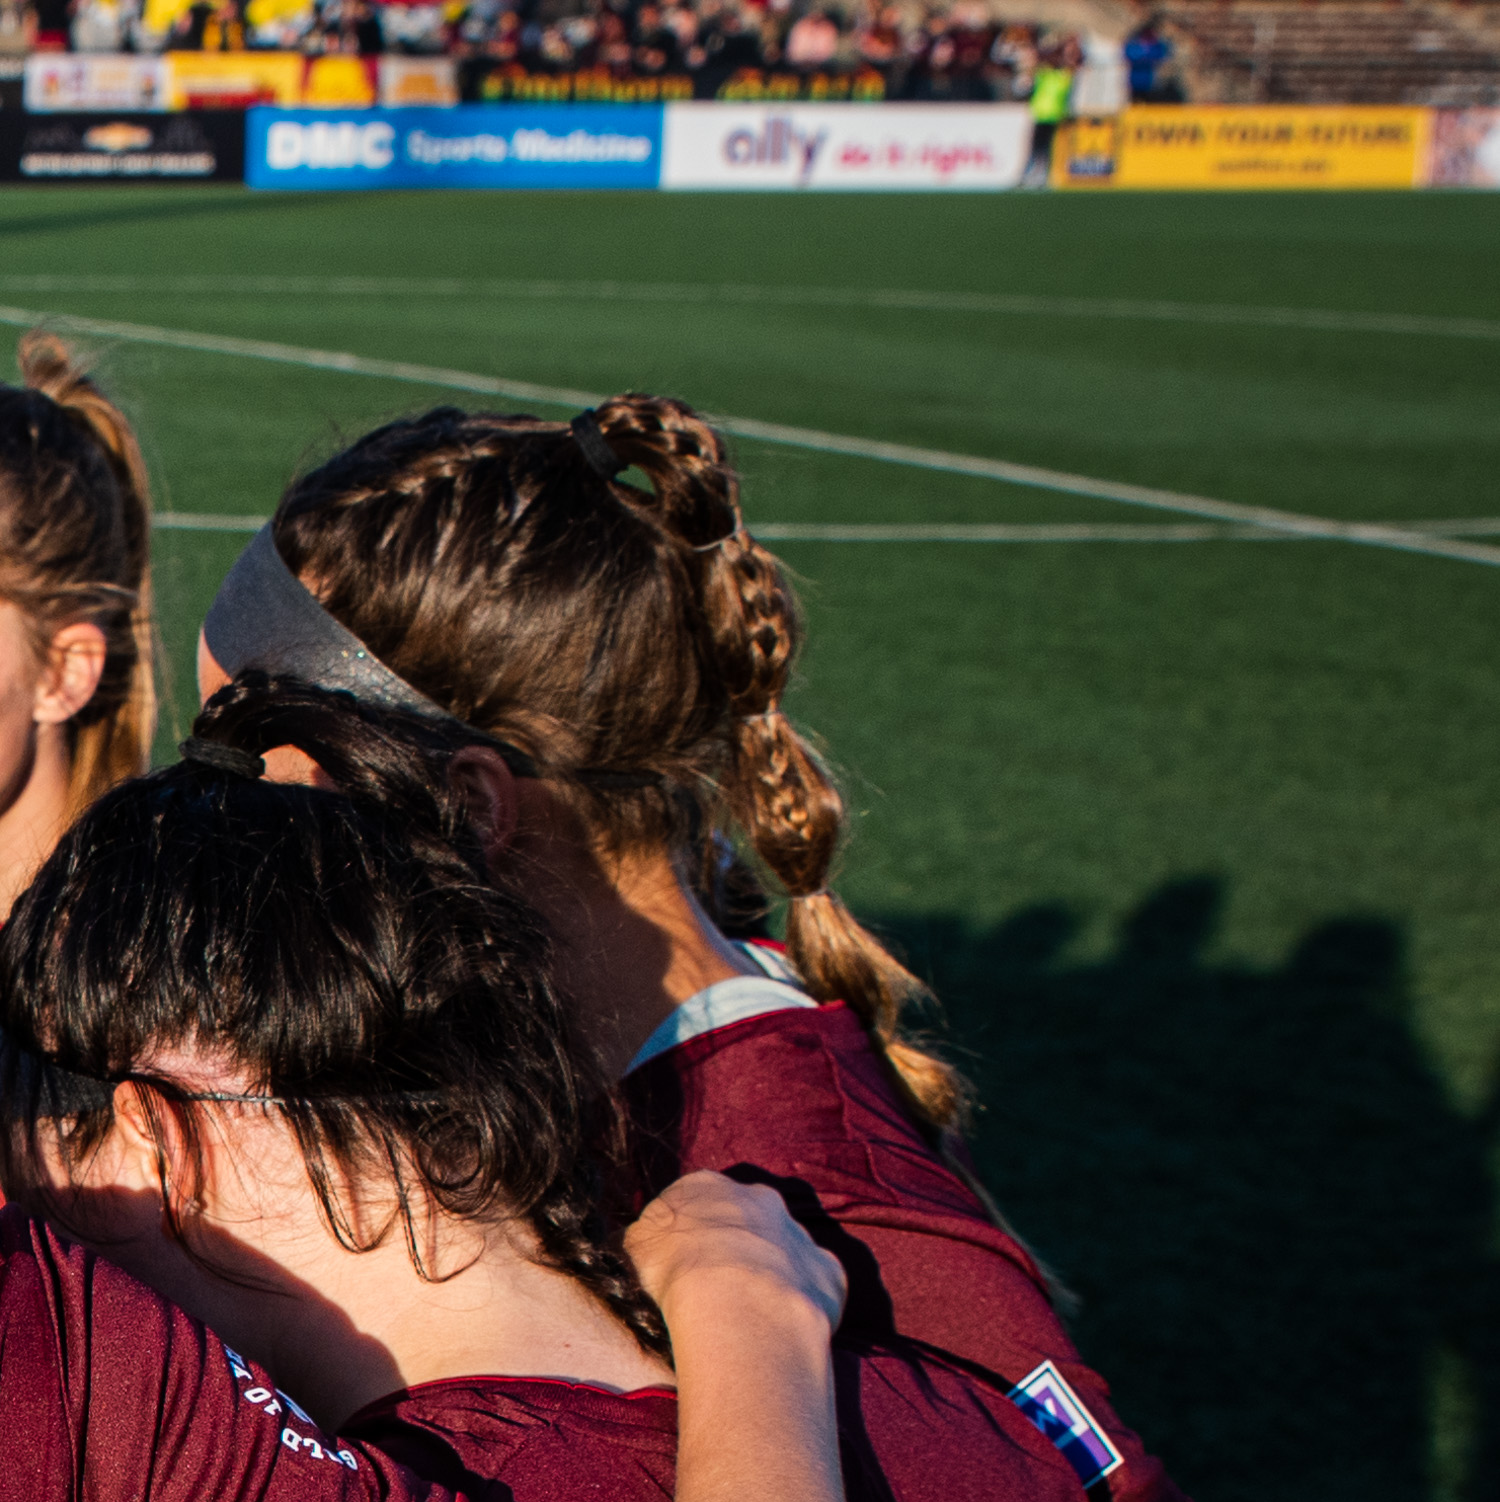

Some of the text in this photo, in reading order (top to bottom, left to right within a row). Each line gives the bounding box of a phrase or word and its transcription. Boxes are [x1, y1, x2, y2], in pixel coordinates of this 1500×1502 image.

[266, 120, 652, 170] DMC Sports Medicine
[723, 113, 827, 187] ally
